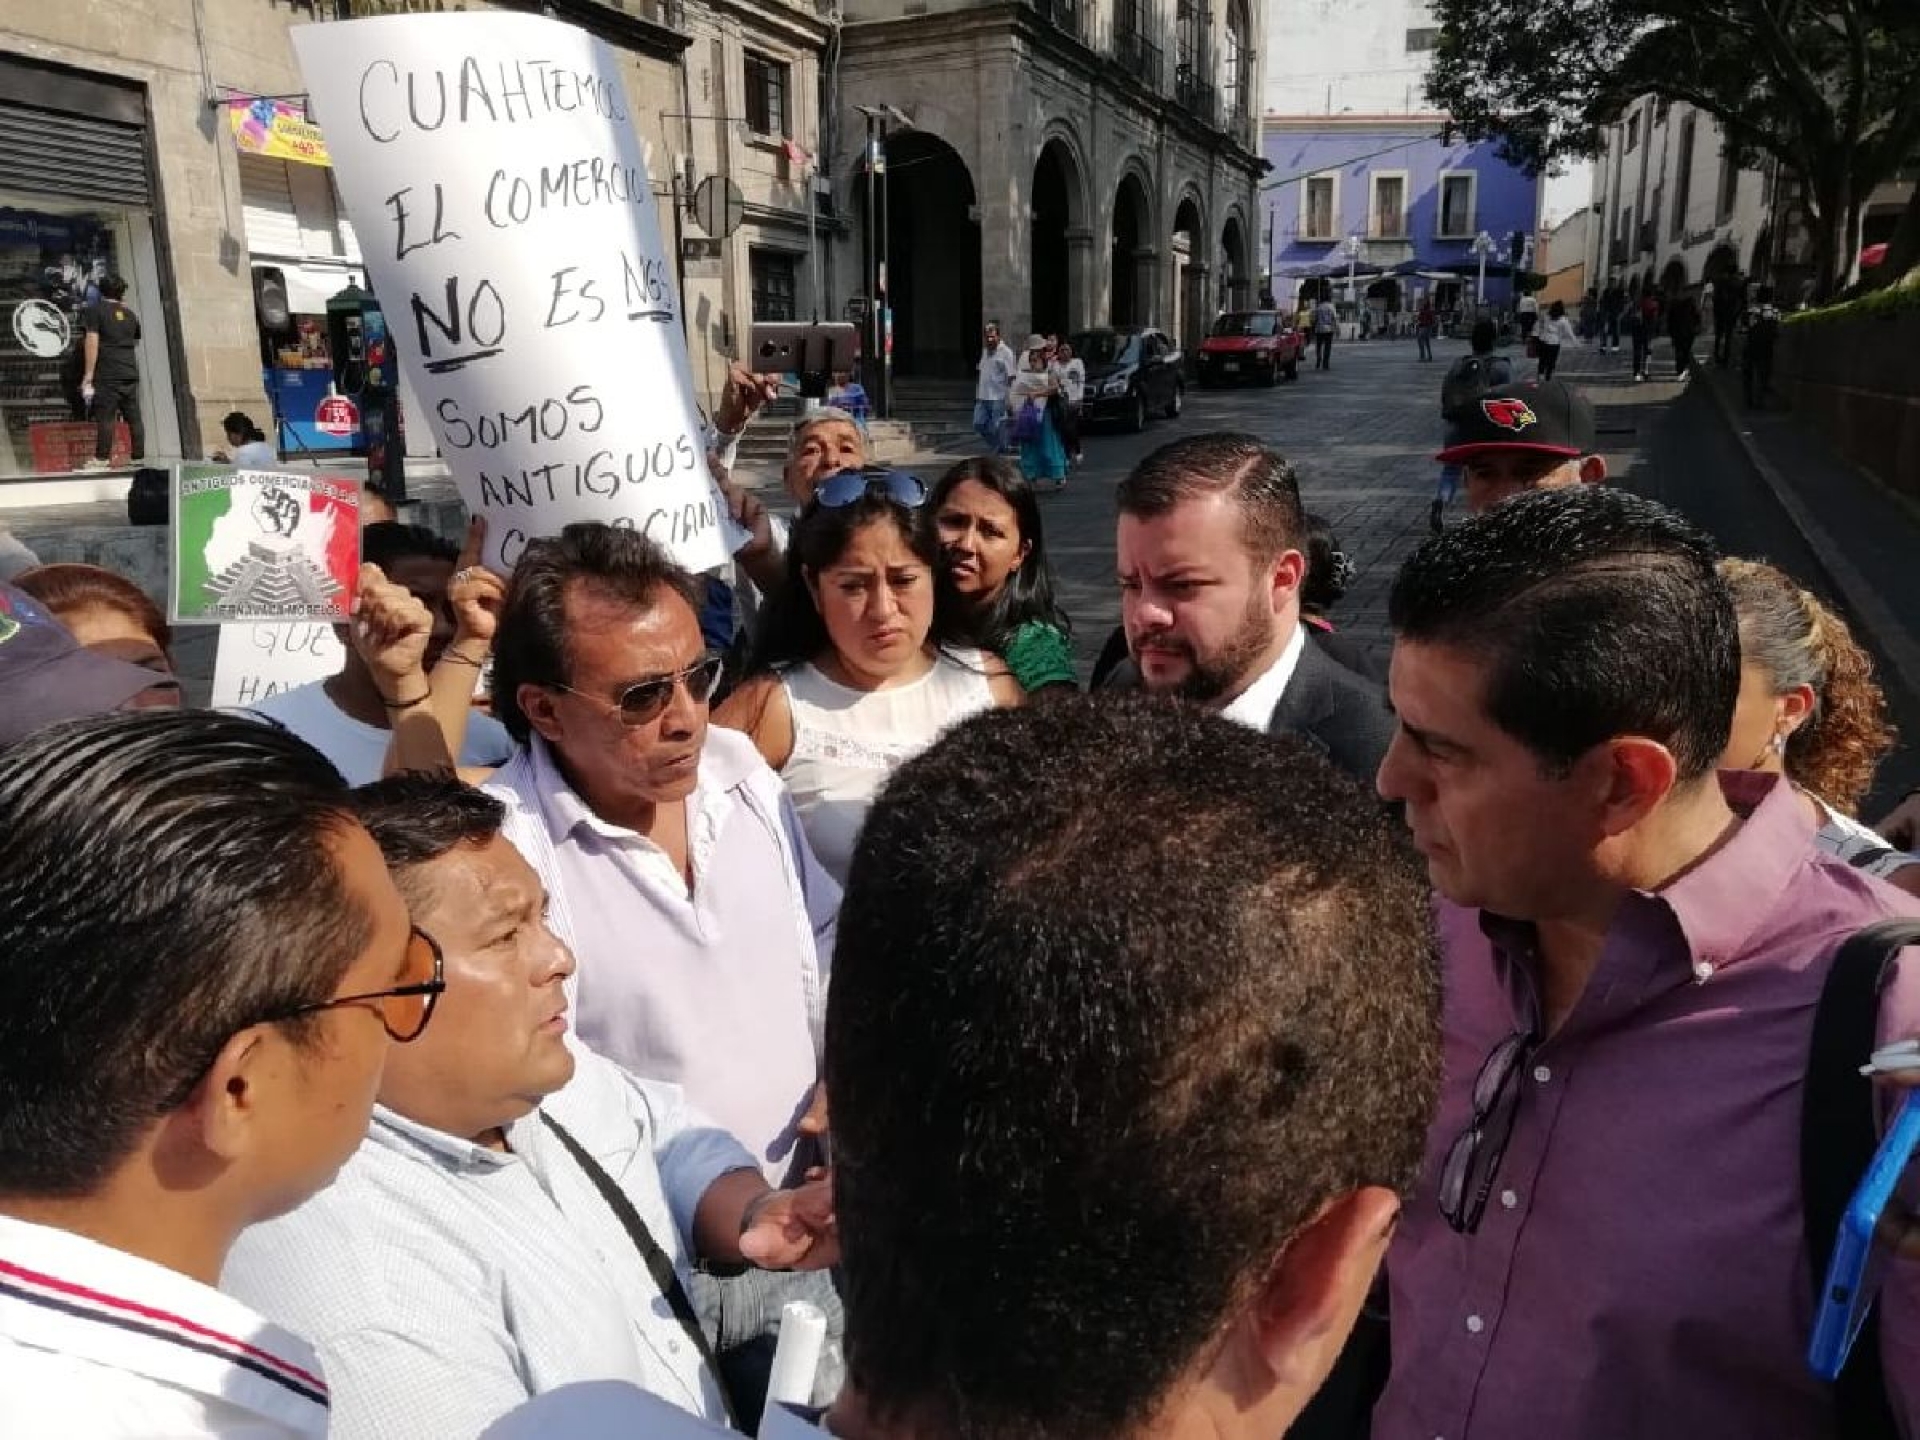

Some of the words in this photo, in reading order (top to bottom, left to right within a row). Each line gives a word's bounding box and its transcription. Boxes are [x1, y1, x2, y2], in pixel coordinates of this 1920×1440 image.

[386, 184, 461, 260] EL
[411, 276, 505, 357] NO
[545, 267, 605, 327] ES
[437, 386, 603, 449] SOMOS
[479, 434, 696, 507] ANTIGUOS
